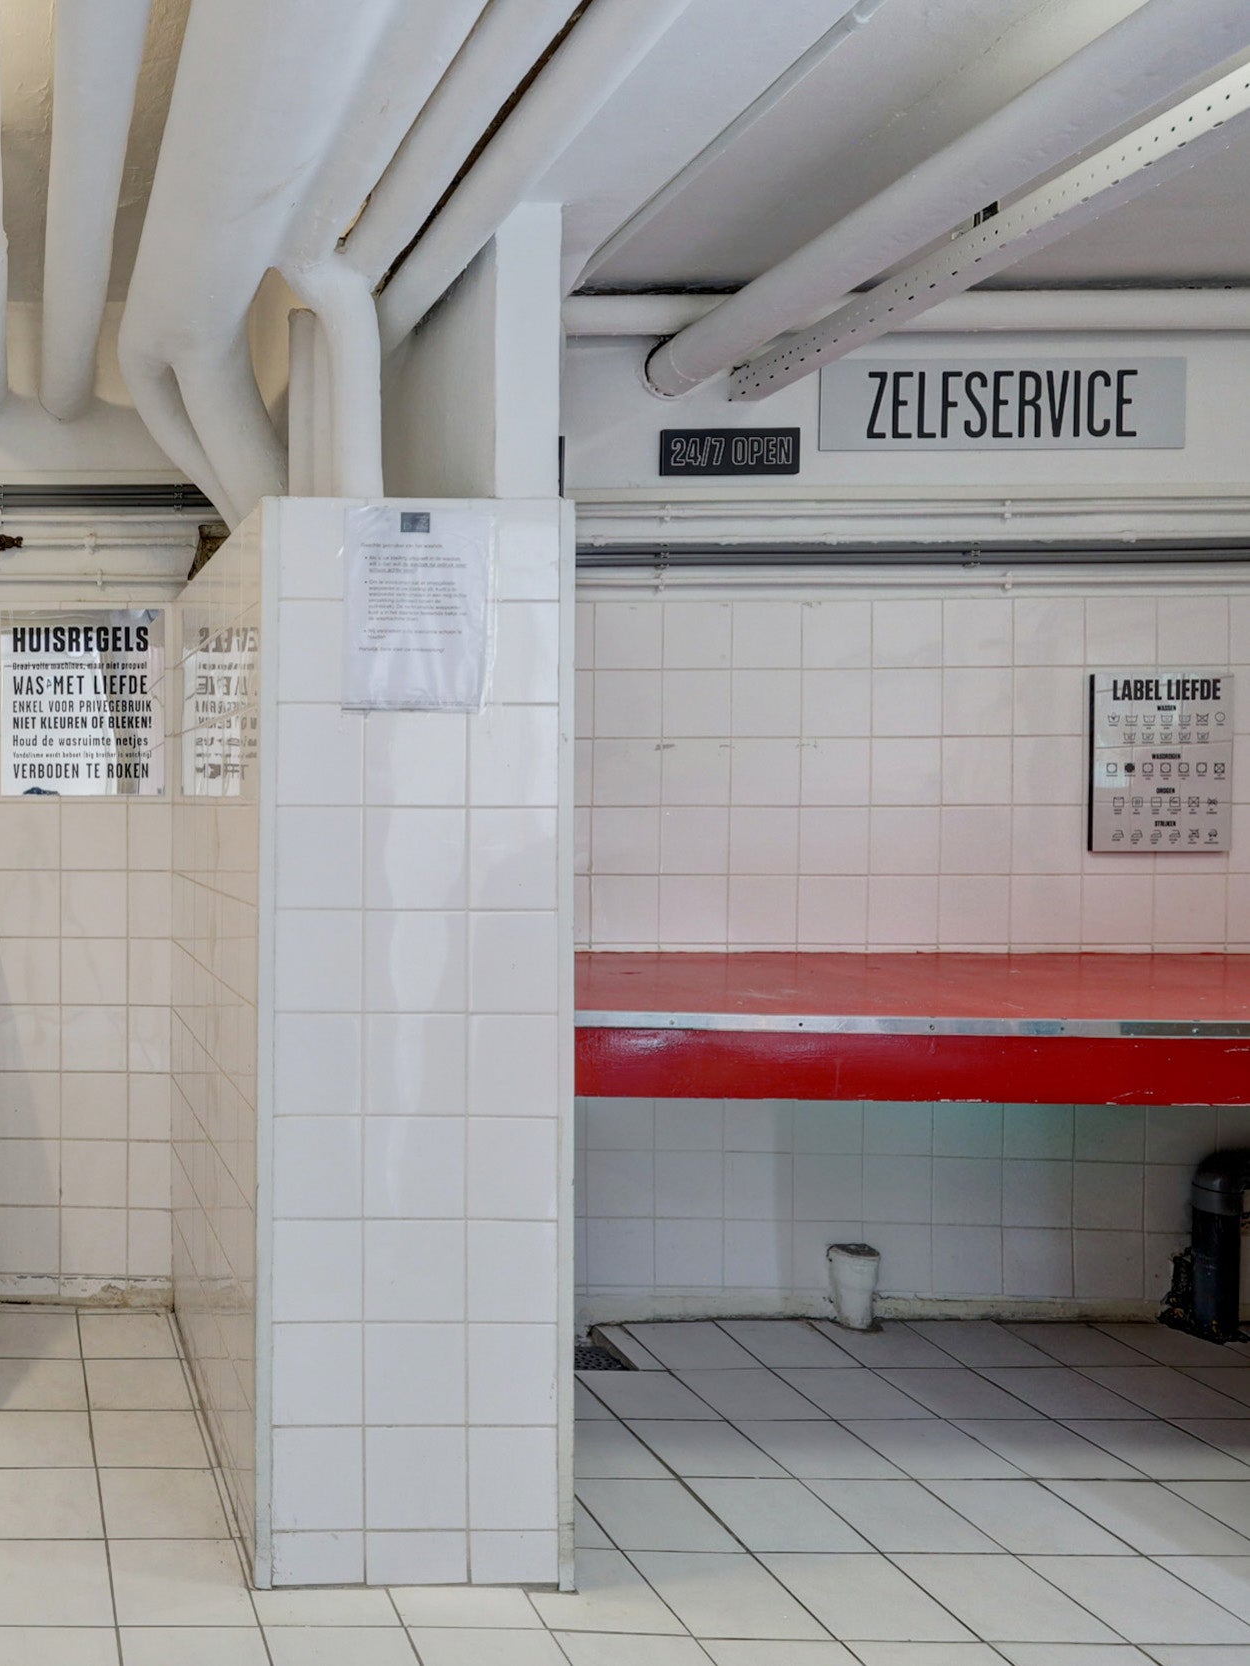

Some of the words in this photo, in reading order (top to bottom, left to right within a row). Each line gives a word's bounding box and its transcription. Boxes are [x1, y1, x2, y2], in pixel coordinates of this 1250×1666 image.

[866, 369, 1139, 439] ZELFSERVICE
[671, 437, 725, 466] 24/7
[731, 436, 793, 465] OPEN
[12, 626, 149, 653] HUISREGELS
[106, 661, 120, 670] niet
[13, 675, 44, 695] WAS
[53, 675, 85, 695] MET
[93, 675, 148, 695] LIEFDE
[1112, 679, 1163, 702] LABEL
[1166, 678, 1222, 701] LIEFDE
[12, 701, 44, 713] ENKEL
[49, 700, 74, 713] VOOR
[12, 716, 37, 730] NIET
[40, 716, 88, 730] KLEUREN
[91, 716, 104, 729] OF
[108, 716, 152, 729] BLEKEN!
[12, 735, 38, 747] Houd
[42, 735, 54, 747] de
[58, 735, 112, 747] wasruimte
[116, 735, 149, 750] netjes
[13, 763, 80, 779] VERBODEN
[86, 763, 101, 779] TE
[107, 763, 150, 779] ROKEN
